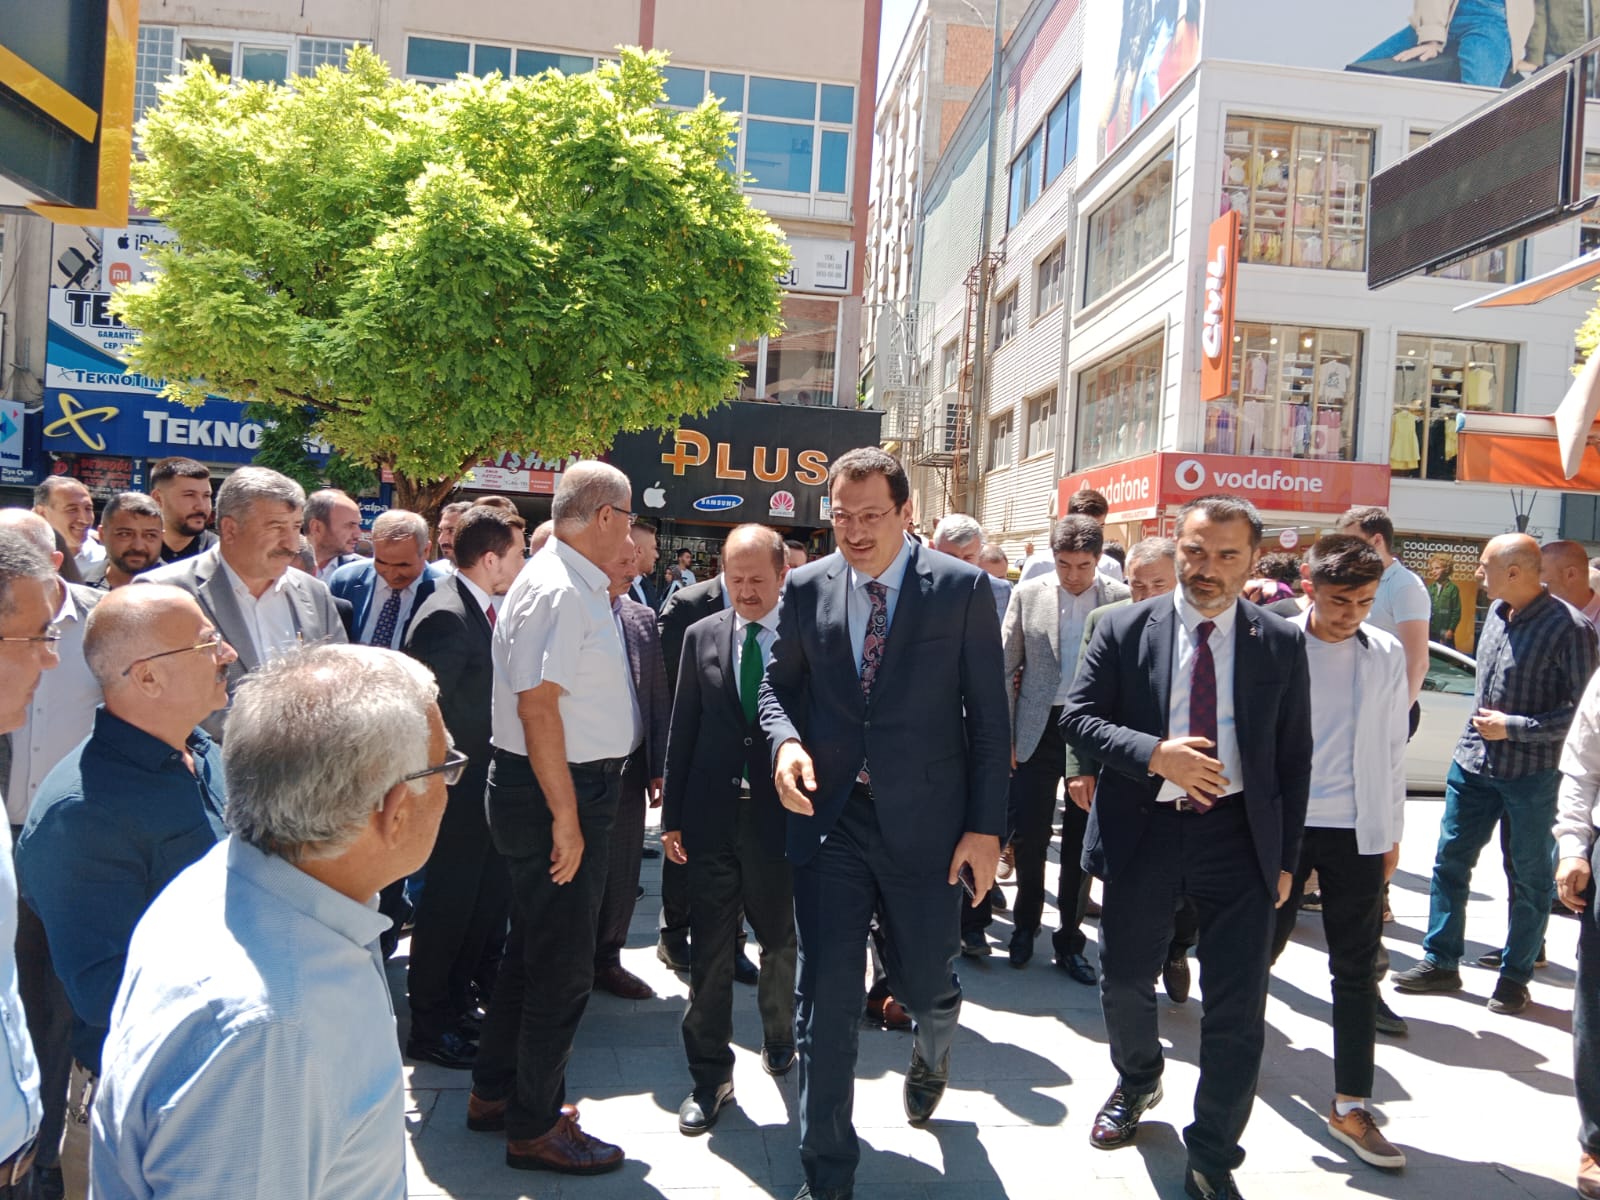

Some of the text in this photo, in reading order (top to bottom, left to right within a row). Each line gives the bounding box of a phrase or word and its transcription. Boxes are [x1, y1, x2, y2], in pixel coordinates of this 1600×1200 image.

[661, 429, 829, 486] PLUS
[1213, 469, 1323, 492] vodafone
[701, 499, 737, 507] SAMSUNG
[1403, 541, 1479, 554] COOLCOOLCOOL
